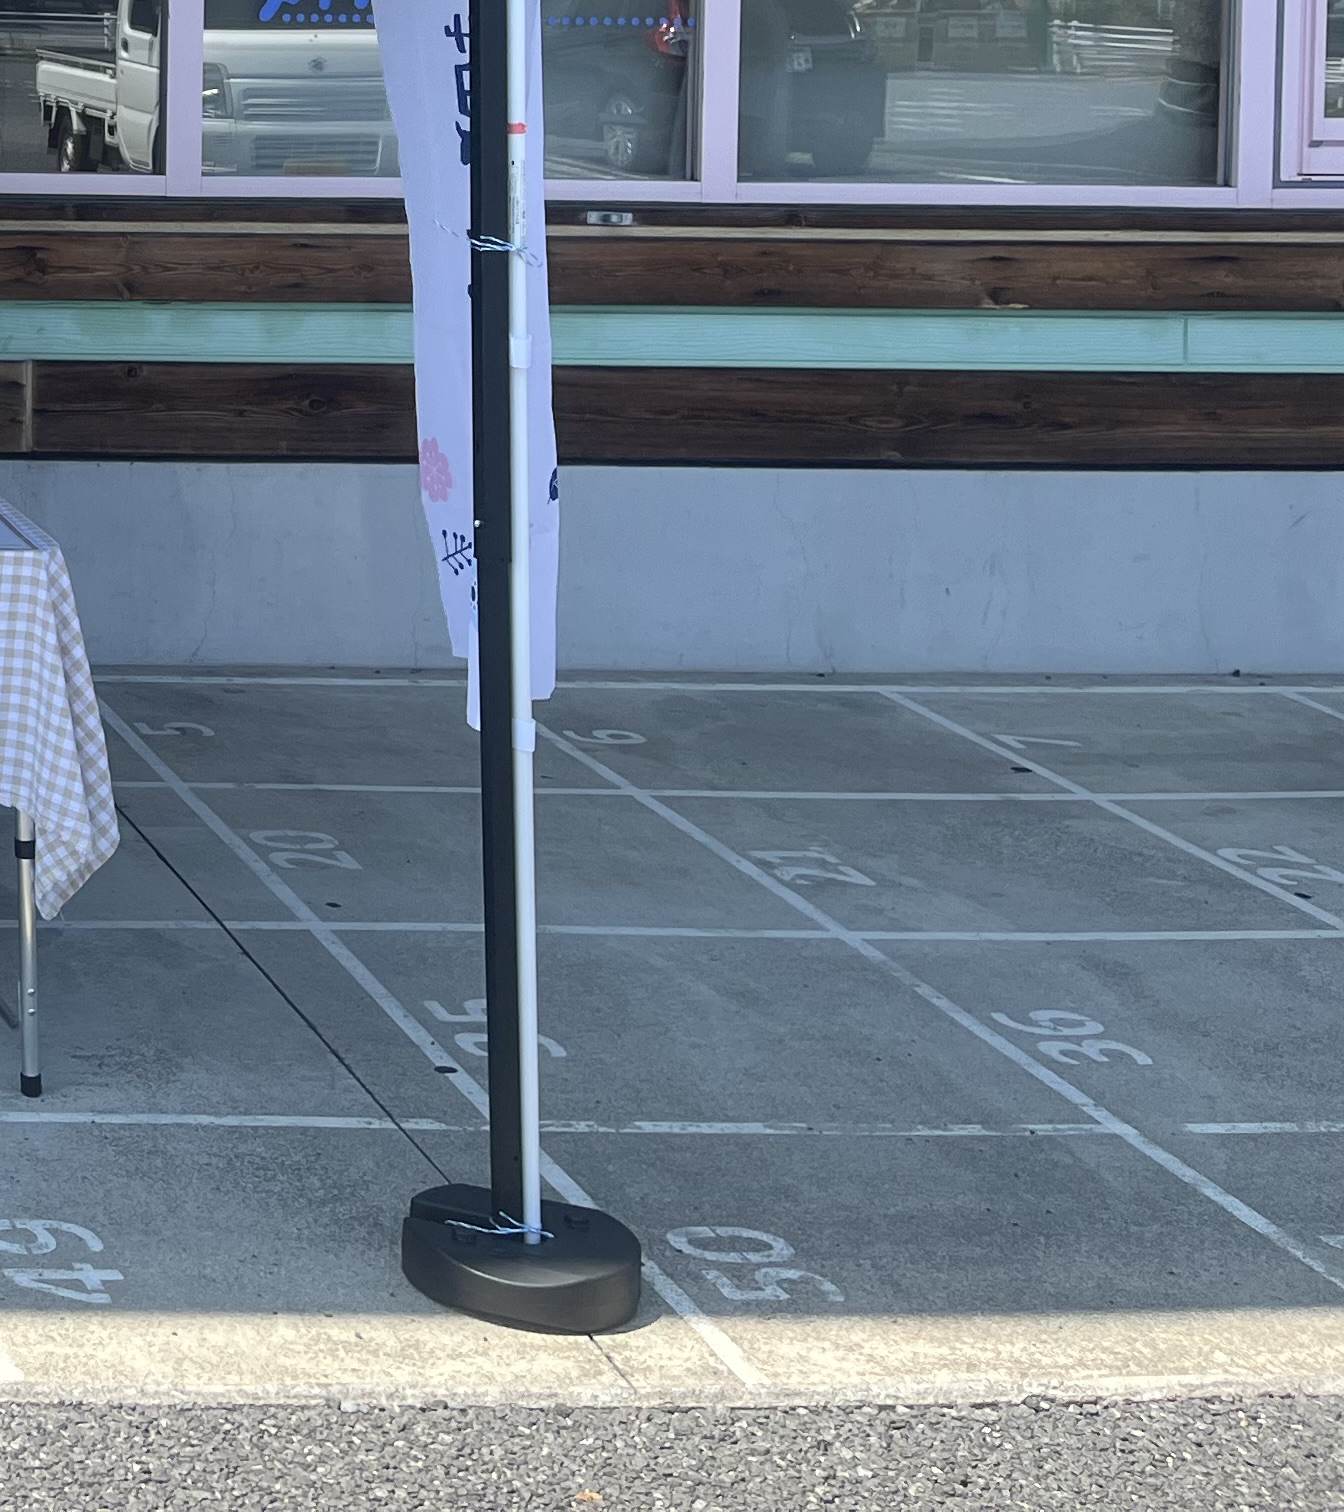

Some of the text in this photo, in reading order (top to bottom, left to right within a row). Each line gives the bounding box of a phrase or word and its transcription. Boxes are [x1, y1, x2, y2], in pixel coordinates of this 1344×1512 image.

[133, 721, 215, 737] 5
[562, 729, 646, 746] 6
[248, 829, 364, 871] 20
[1216, 845, 1344, 885] 22
[991, 1008, 1153, 1067] 36
[666, 1226, 846, 1303] 50
